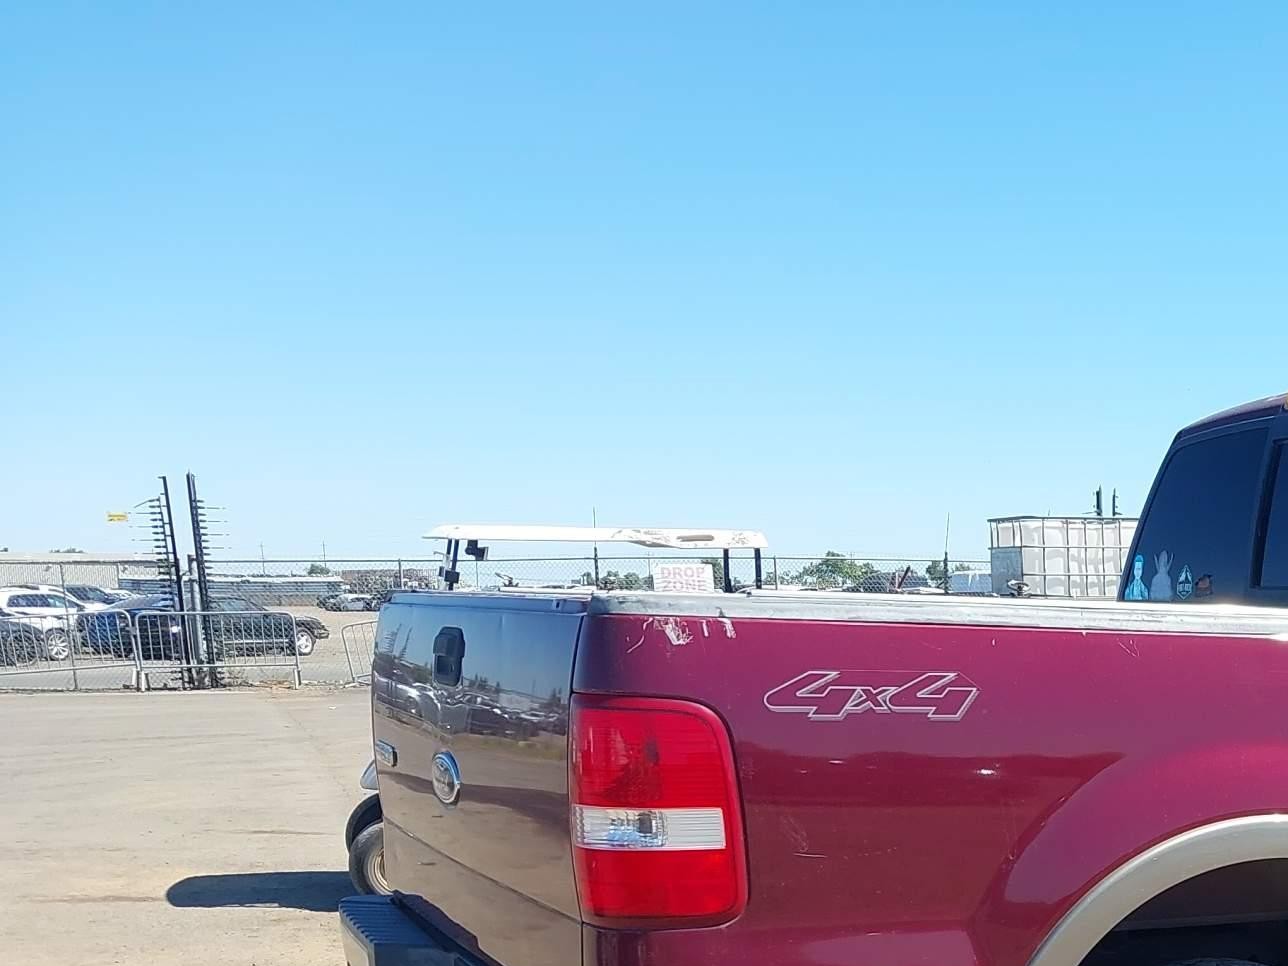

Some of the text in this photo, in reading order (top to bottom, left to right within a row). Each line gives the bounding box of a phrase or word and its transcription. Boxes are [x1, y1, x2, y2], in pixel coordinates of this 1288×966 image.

[660, 567, 705, 579] DROP
[662, 579, 707, 592] ZONE
[763, 670, 980, 721] 4x4
